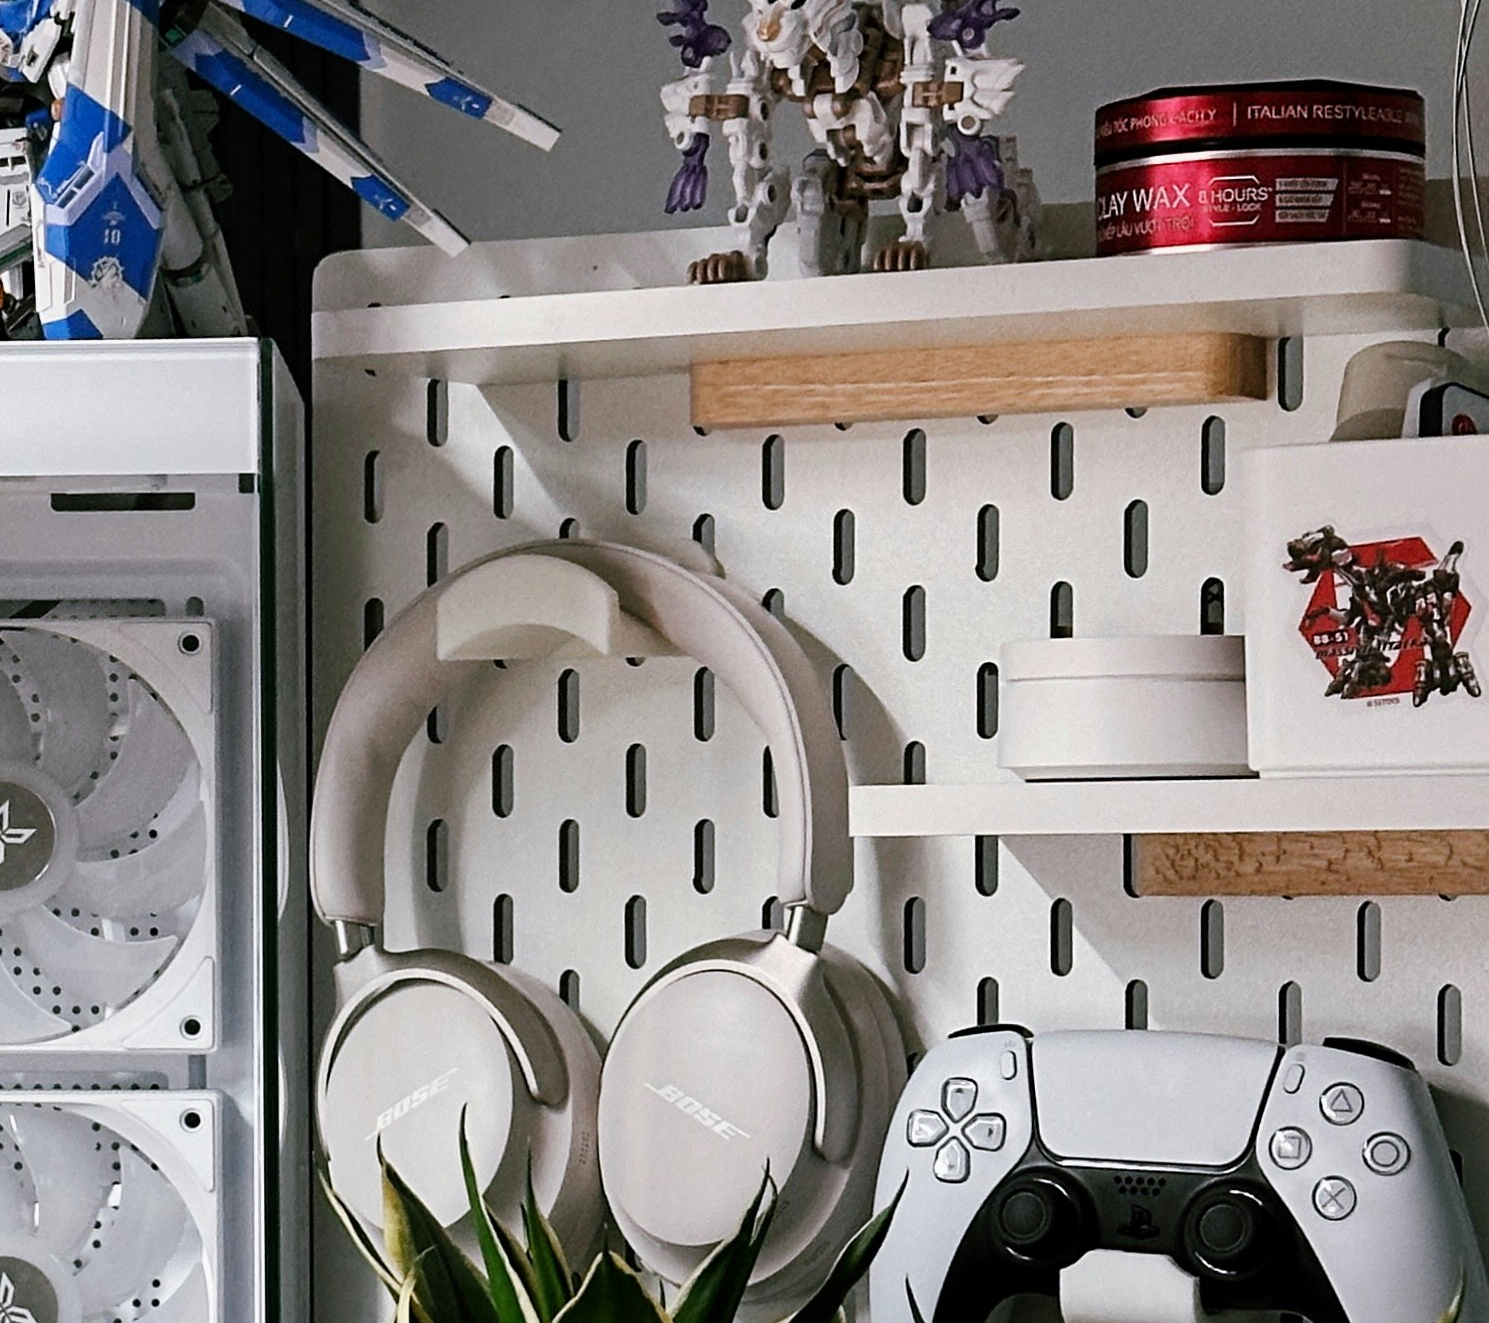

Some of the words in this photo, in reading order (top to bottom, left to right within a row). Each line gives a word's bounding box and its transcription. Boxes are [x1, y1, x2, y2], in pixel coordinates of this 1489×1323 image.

[1247, 104, 1308, 119] ITALIAN
[1132, 183, 1191, 213] WAX
[364, 1068, 458, 1141] BOSE
[644, 1083, 750, 1139] BOSE
